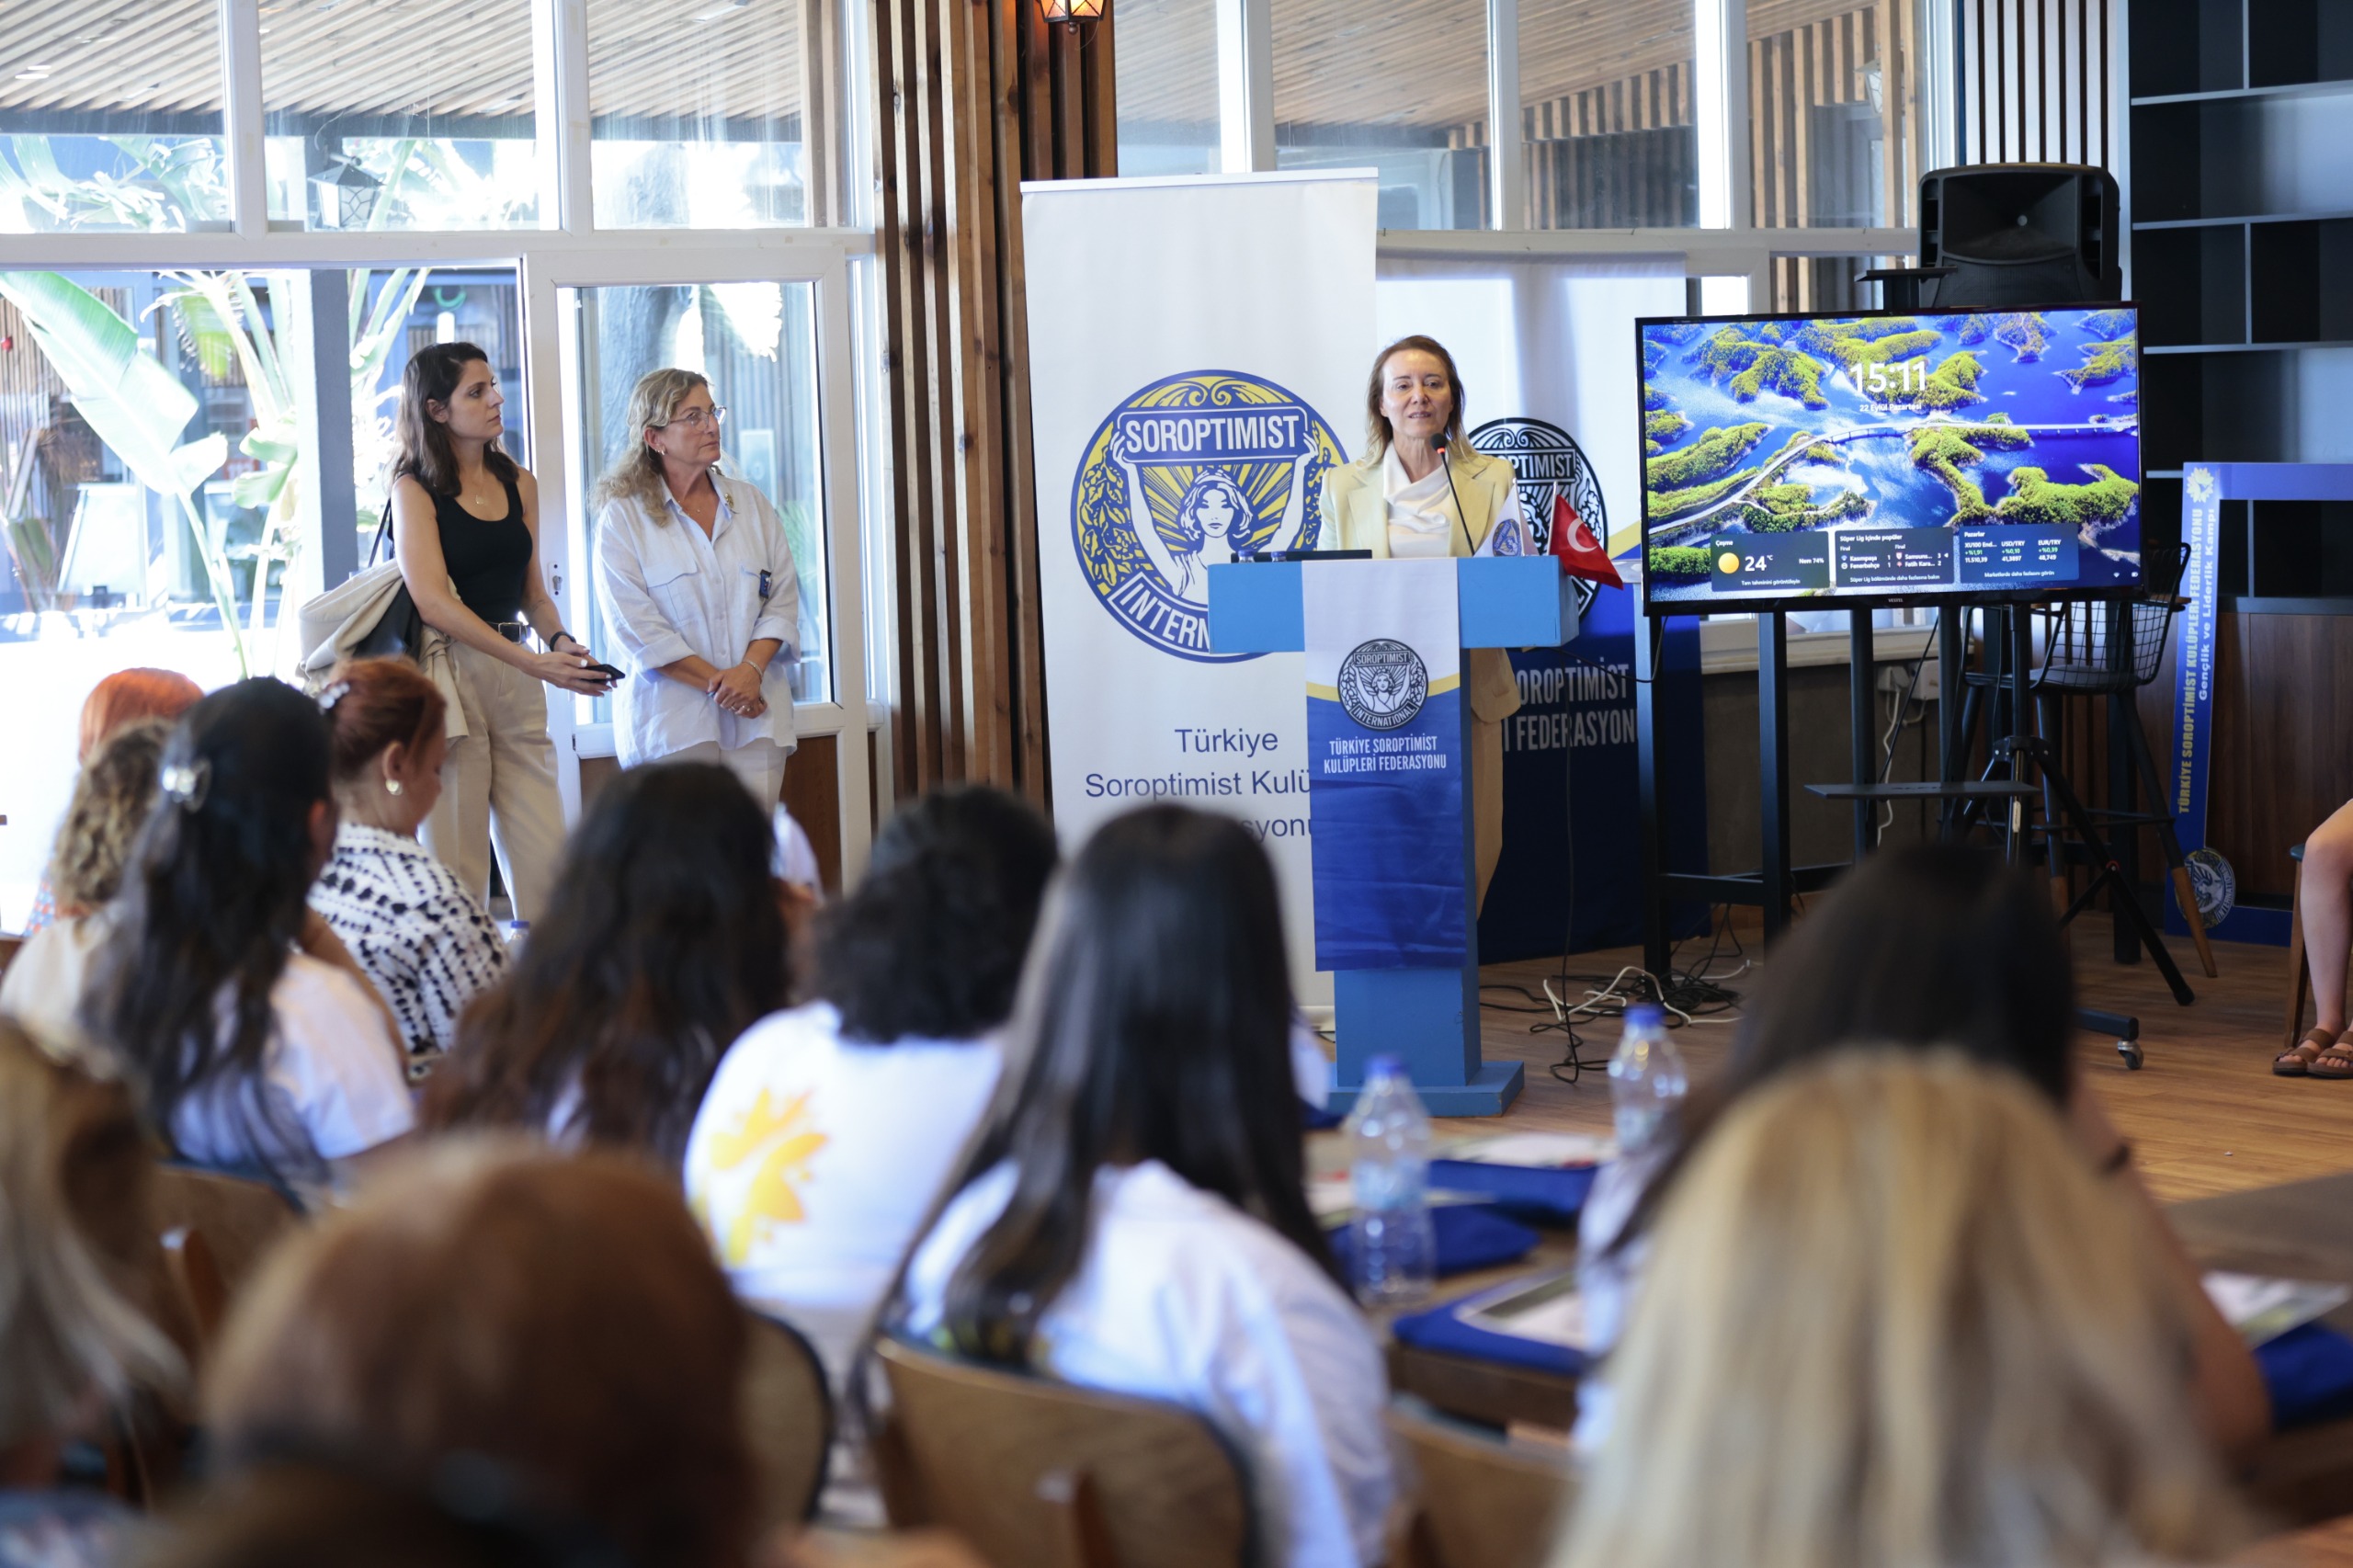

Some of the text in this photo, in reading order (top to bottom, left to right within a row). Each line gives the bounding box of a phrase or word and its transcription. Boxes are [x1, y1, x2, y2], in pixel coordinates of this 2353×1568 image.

[1849, 361, 1926, 392] 15:11
[1125, 415, 1300, 453] SOROPTIMIST
[2189, 508, 2203, 597] FEDERASYONU
[2202, 561, 2213, 618] Liderlik
[1120, 583, 1210, 649] INTERN
[2203, 622, 2211, 639] ve
[1356, 653, 1408, 665] SOROPTIMIST
[2199, 643, 2211, 701] Gençlik
[1517, 656, 1629, 705] OROPTİMİST
[1354, 705, 1415, 727] INTERNATIONAL
[1517, 709, 1640, 752] FEDERASYON
[2181, 670, 2197, 758] SOROPTİMİST
[1175, 728, 1279, 757] Türkiye
[1329, 733, 1438, 756] TÜRKİYE SOROPTİMİST
[1324, 754, 1447, 774] KULÜPLERİ FEDERASYONU
[1086, 769, 1310, 801] Soroptimist Kulü
[2177, 761, 2192, 814] TÜRKİYE
